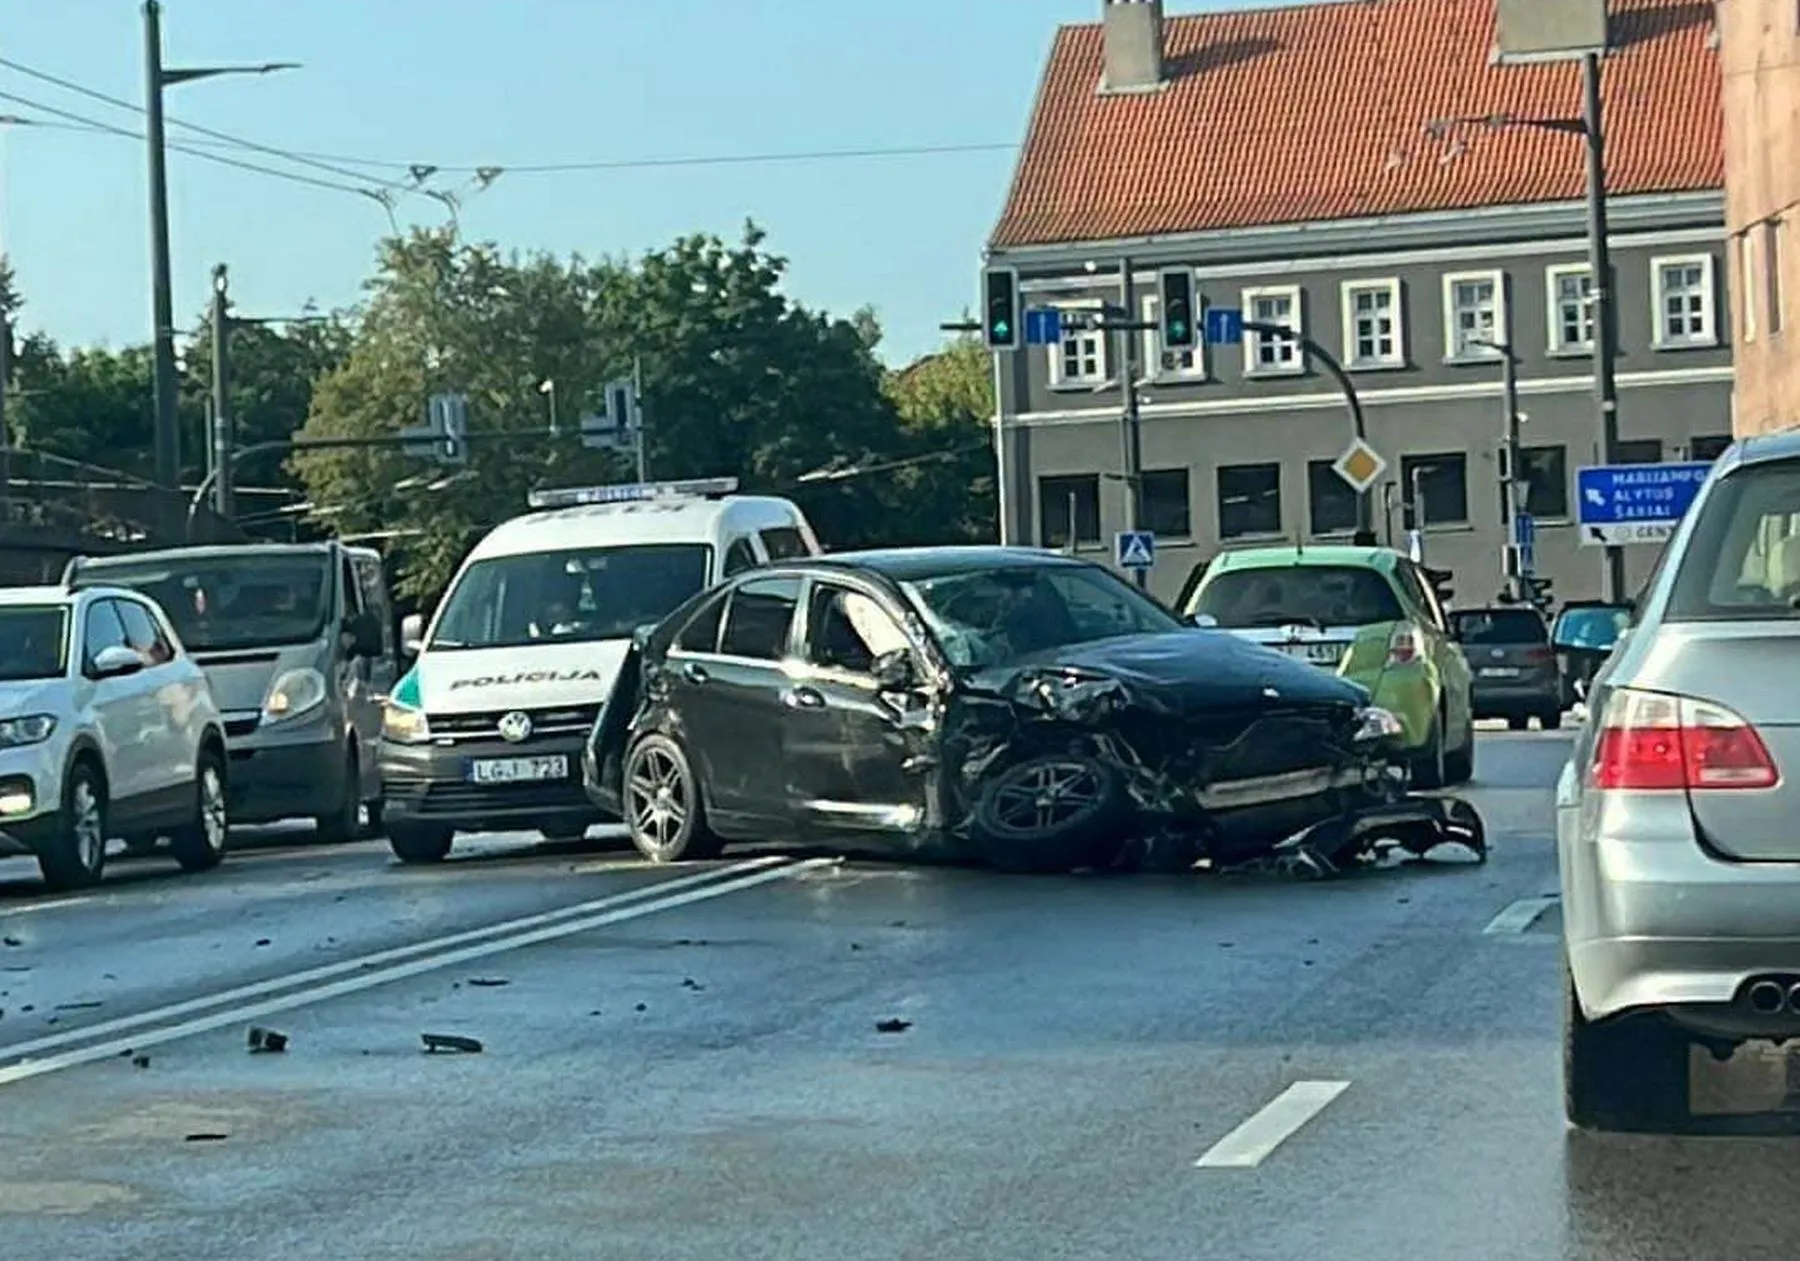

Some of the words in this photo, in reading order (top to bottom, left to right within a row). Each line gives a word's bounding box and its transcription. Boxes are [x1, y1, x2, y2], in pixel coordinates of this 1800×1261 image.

[1611, 470, 1706, 485] MARIJAMPO
[1613, 486, 1674, 502] ALYTUS
[1636, 525, 1672, 538] CEN
[450, 669, 600, 690] POLICIJA
